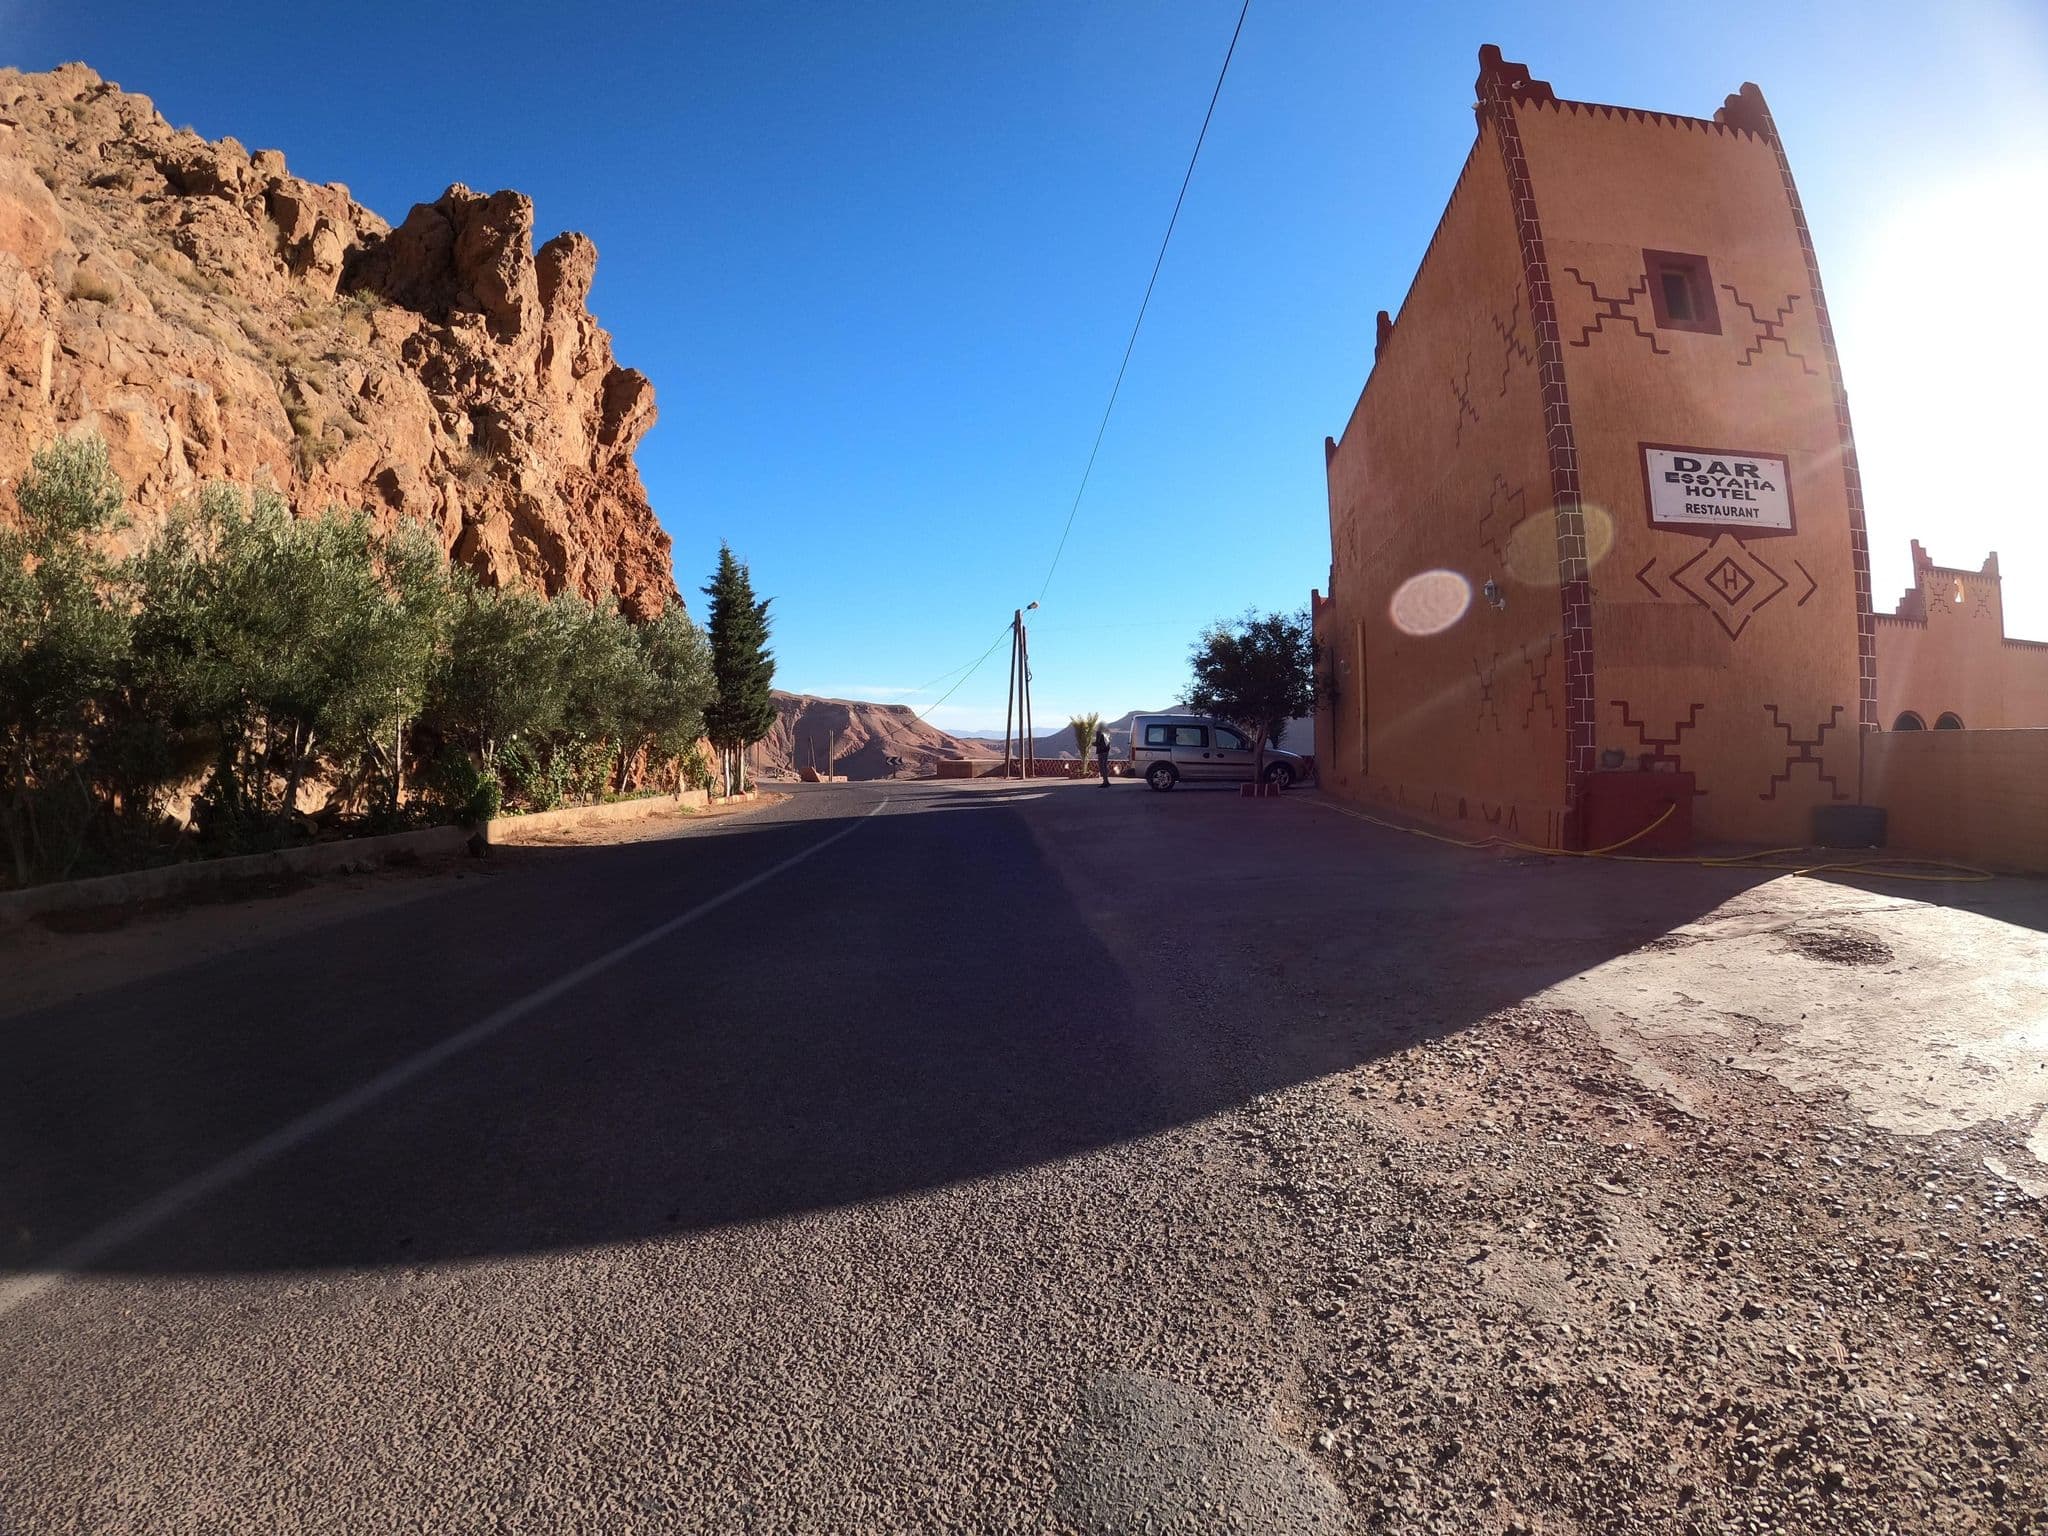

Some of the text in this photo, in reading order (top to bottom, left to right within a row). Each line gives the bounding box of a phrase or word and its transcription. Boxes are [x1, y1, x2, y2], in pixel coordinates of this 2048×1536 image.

[1674, 457, 1761, 478] DAR
[1665, 472, 1776, 491] ESSYAHA
[1686, 486, 1756, 501] HOTEL
[1686, 503, 1759, 518] RESTAURANT
[1724, 568, 1737, 590] H
